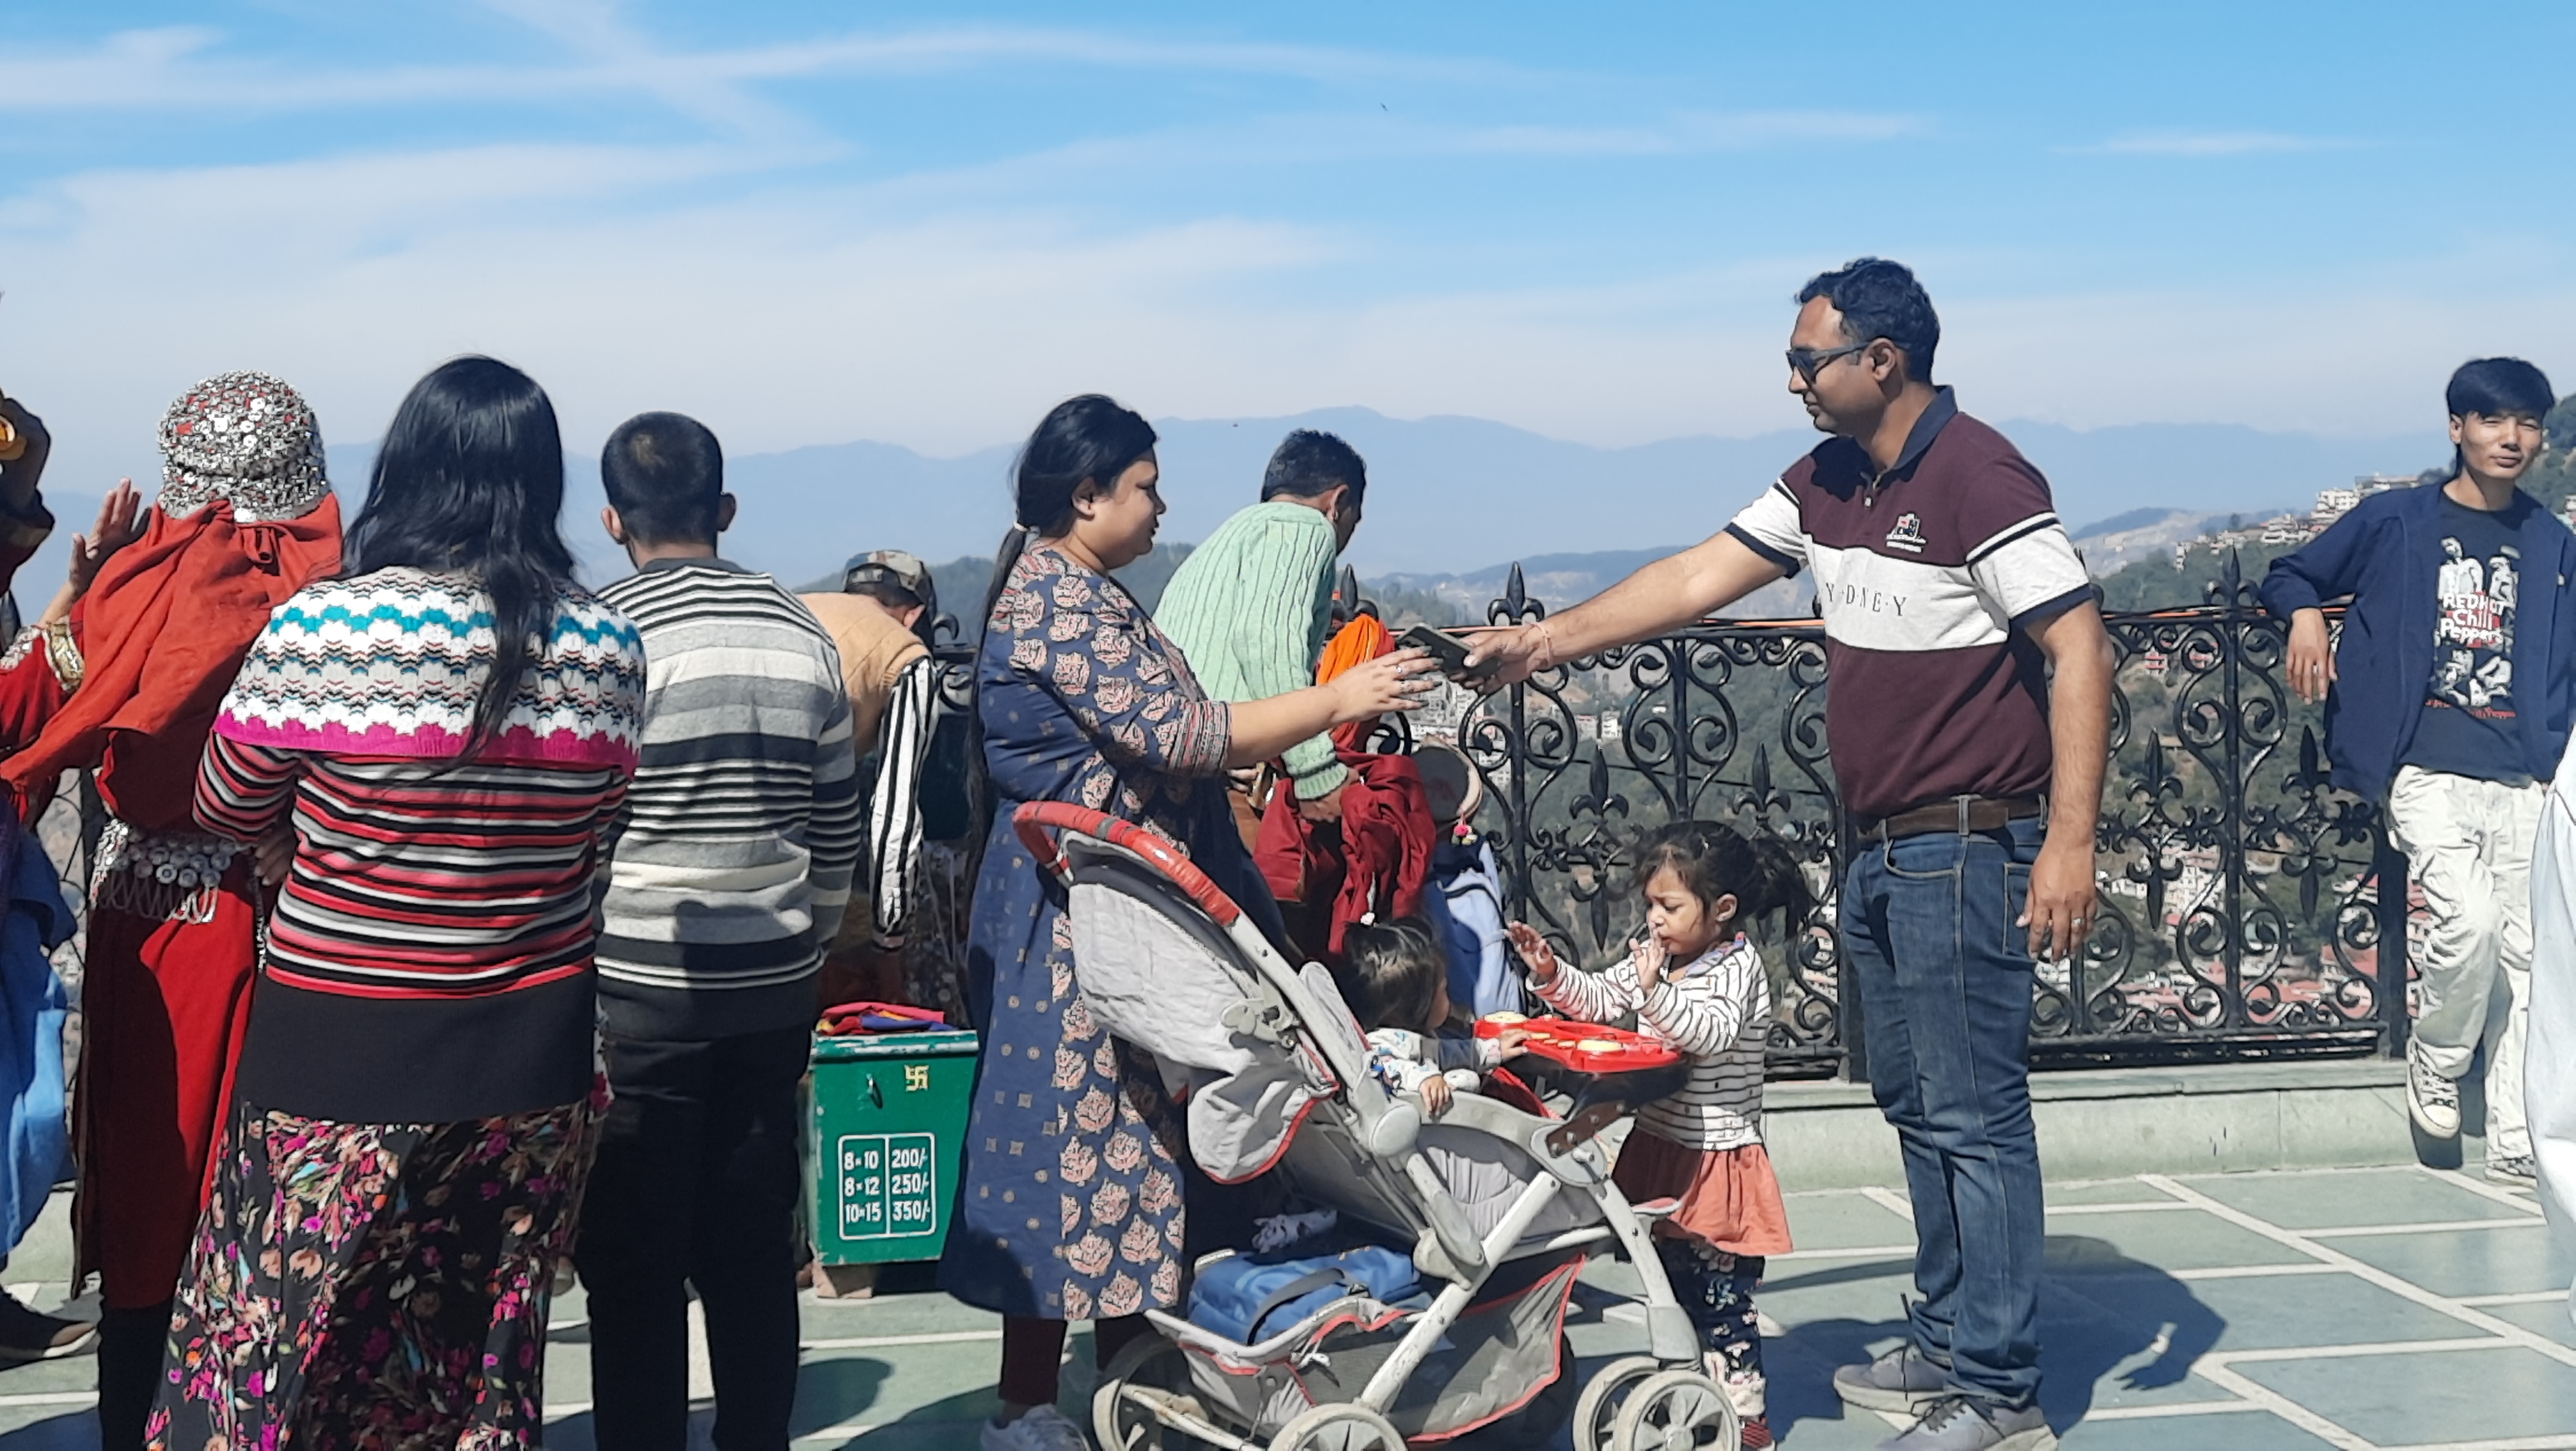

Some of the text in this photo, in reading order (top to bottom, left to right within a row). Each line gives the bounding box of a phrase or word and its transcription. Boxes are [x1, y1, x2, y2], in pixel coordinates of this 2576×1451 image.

[1826, 583, 1906, 616] YDNEY
[891, 1147, 928, 1170] 200/-
[892, 1172, 929, 1195] 250/-
[892, 1199, 930, 1223] 350/-
